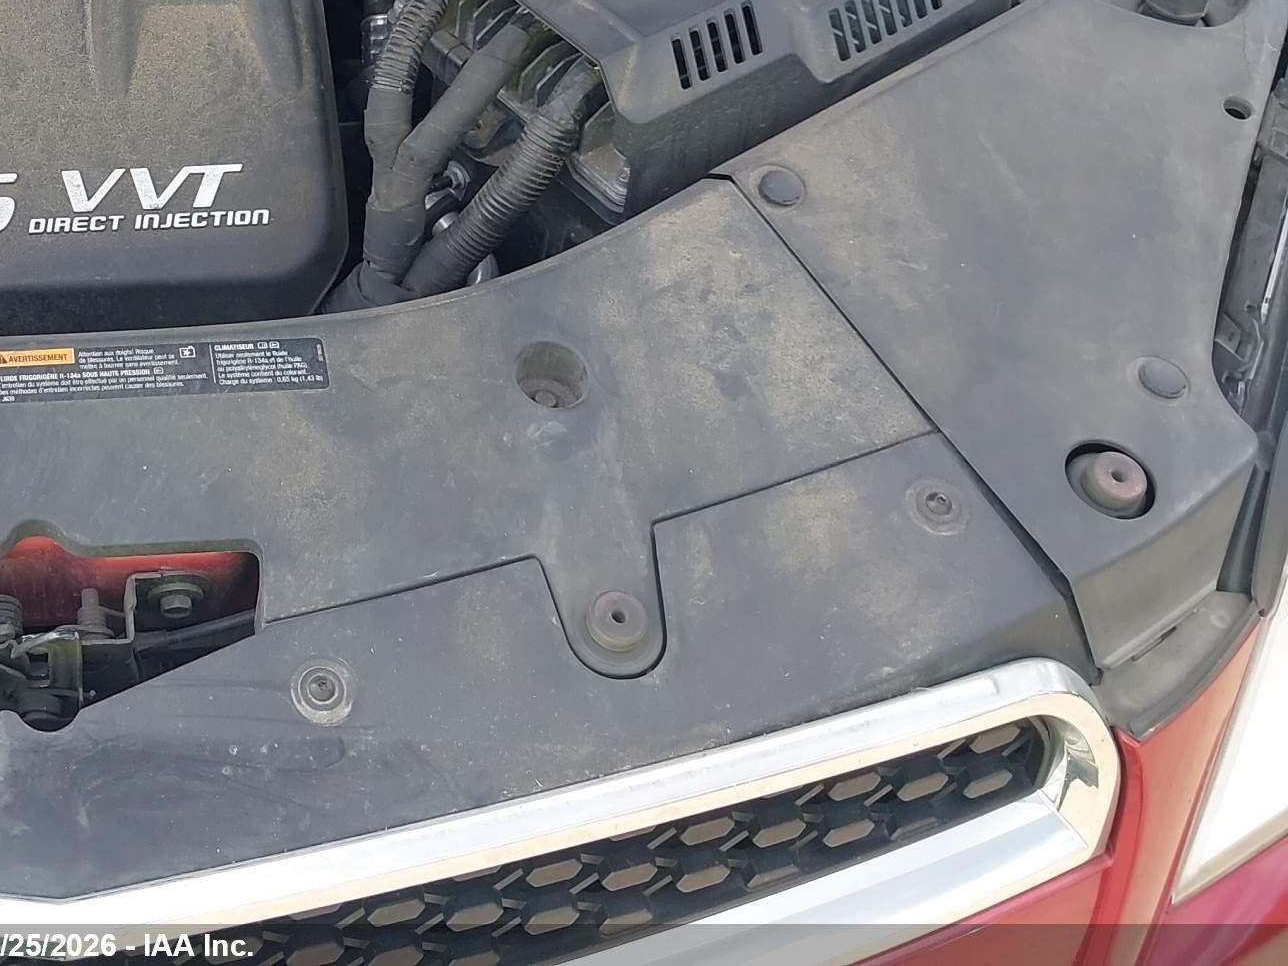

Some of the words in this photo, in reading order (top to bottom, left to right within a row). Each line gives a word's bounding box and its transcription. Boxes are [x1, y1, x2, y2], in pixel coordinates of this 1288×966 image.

[61, 163, 243, 212] VVT
[28, 214, 124, 234] DIRECT
[135, 209, 270, 230] INJECTION
[9, 354, 67, 362] AVERTISSEMENT
